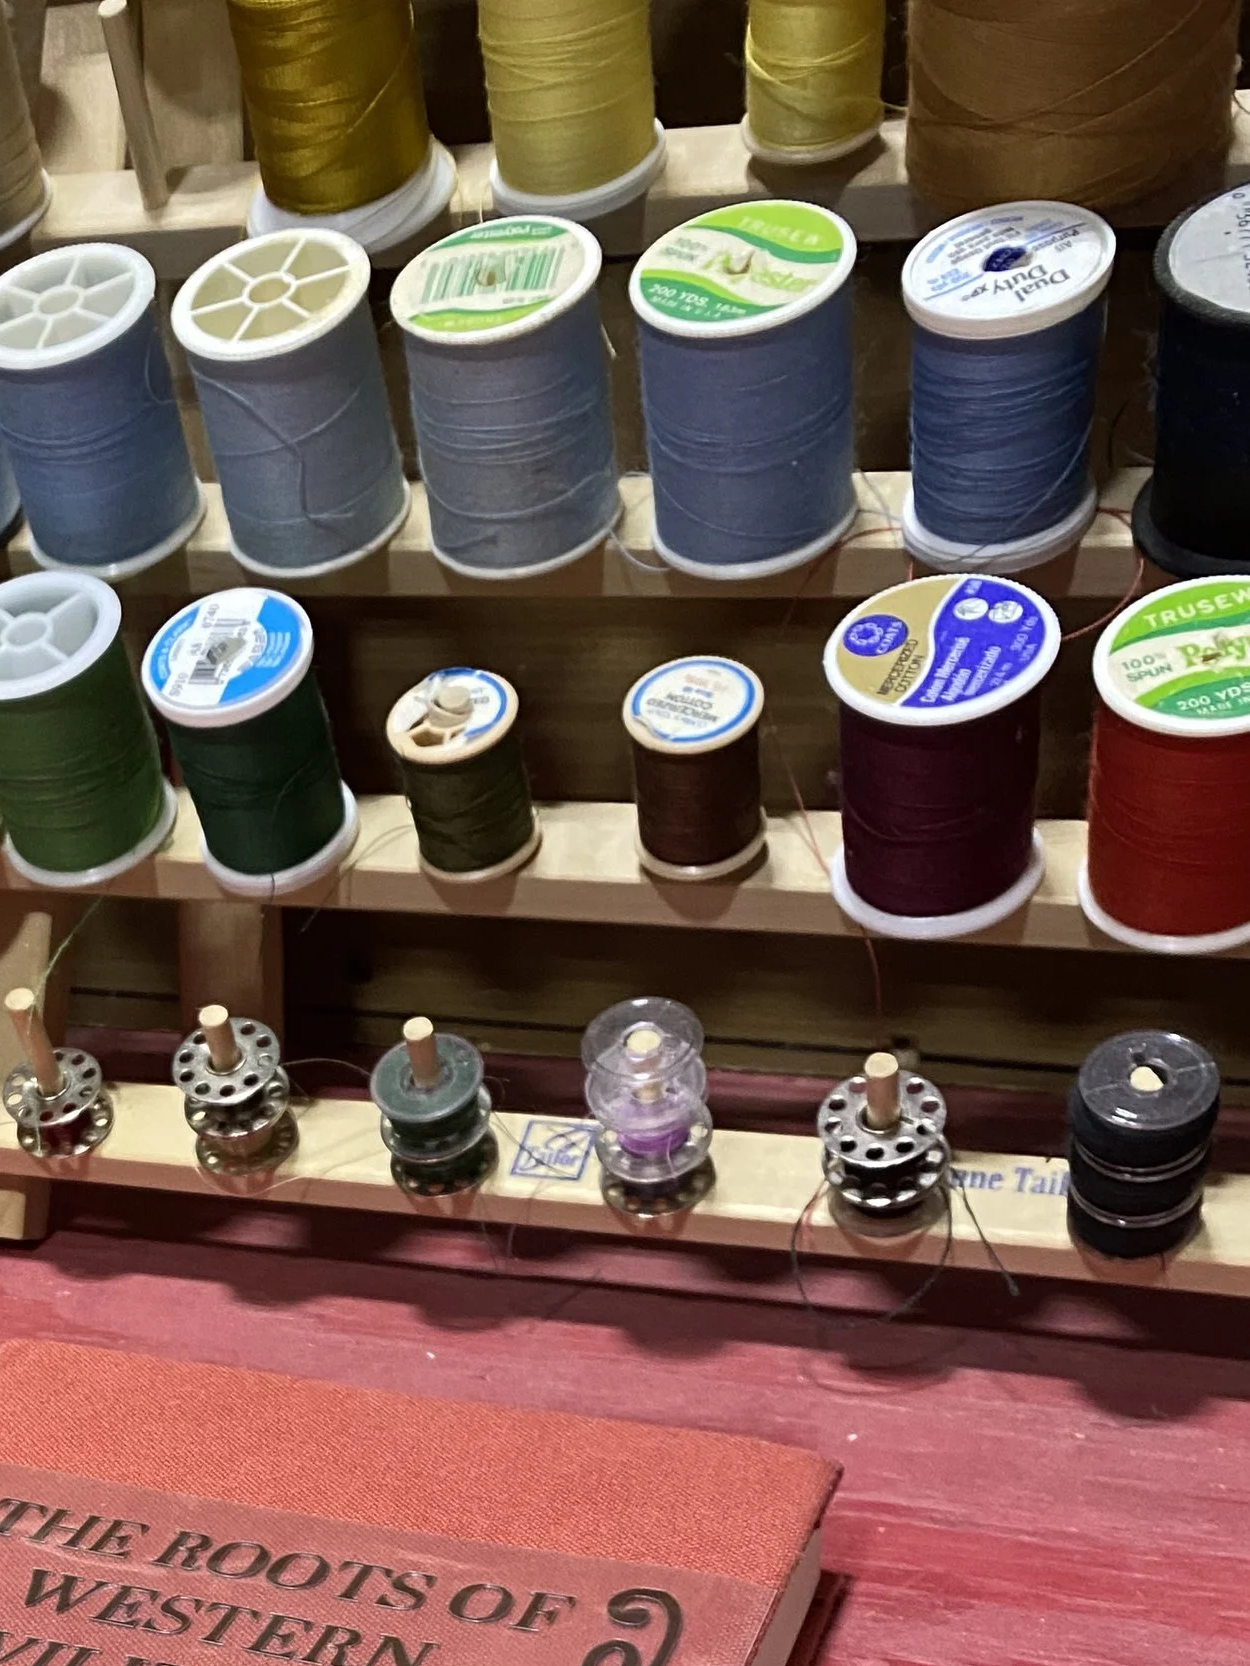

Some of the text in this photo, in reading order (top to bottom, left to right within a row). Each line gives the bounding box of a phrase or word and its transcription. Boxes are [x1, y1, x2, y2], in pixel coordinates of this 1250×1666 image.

[648, 283, 678, 299] 200
[992, 264, 1049, 296] Duty
[1013, 268, 1071, 303] Dual
[876, 620, 903, 655] COATS
[876, 638, 919, 696] MERCERIZED
[894, 654, 926, 694] COTTON
[1126, 663, 1173, 683] SPUN
[1176, 695, 1211, 711] 200
[1014, 1166, 1070, 1196] Tail
[151, 1529, 438, 1612] ROOTS
[447, 1582, 577, 1632] OF
